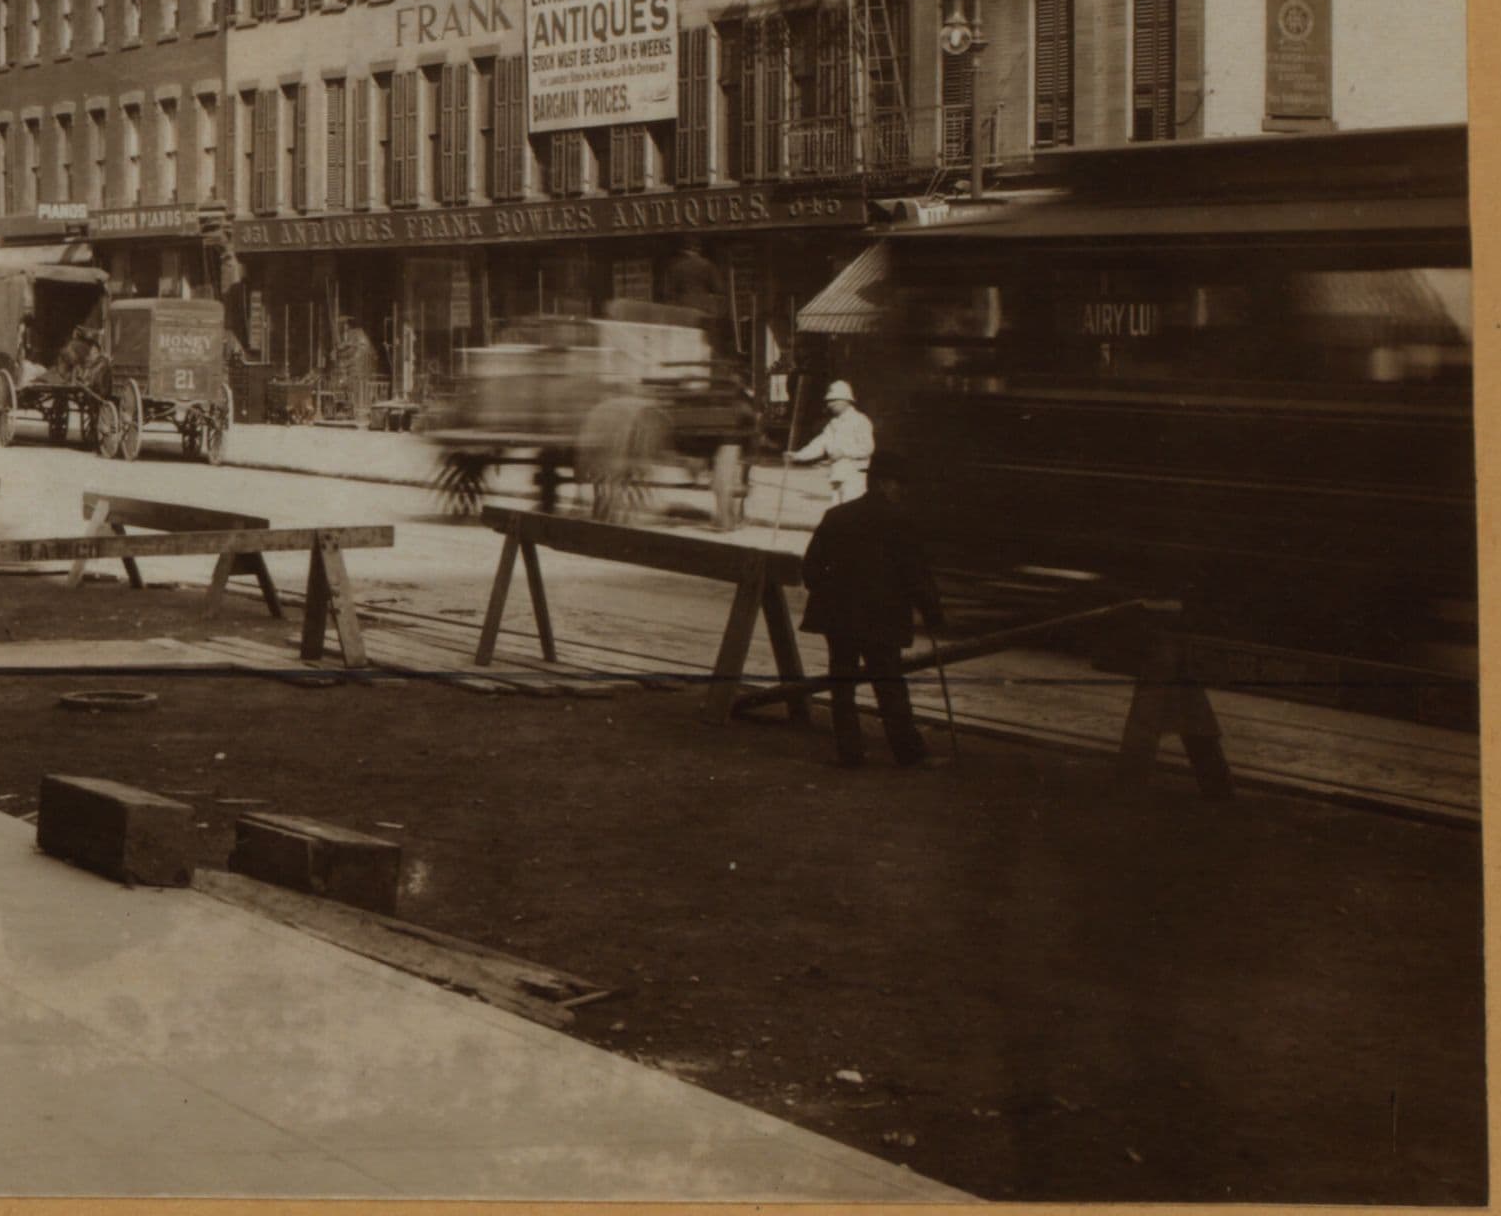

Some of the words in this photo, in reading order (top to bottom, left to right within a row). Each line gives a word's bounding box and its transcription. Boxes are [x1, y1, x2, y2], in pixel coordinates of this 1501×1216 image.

[532, 53, 555, 72] STOCK
[557, 50, 577, 69] MUST
[580, 48, 590, 66] BE
[593, 45, 617, 64] SOLD
[619, 44, 628, 60] IN
[532, 90, 579, 123] BARGAIN
[583, 84, 632, 117] PRICES.
[37, 202, 89, 221] PIANOS
[139, 210, 182, 228] PIANOS
[242, 225, 270, 246] 351
[404, 211, 484, 242] FRANK
[611, 192, 772, 229] ANTIQUES.
[1077, 303, 1126, 336] AIRY
[174, 368, 196, 390] 21
